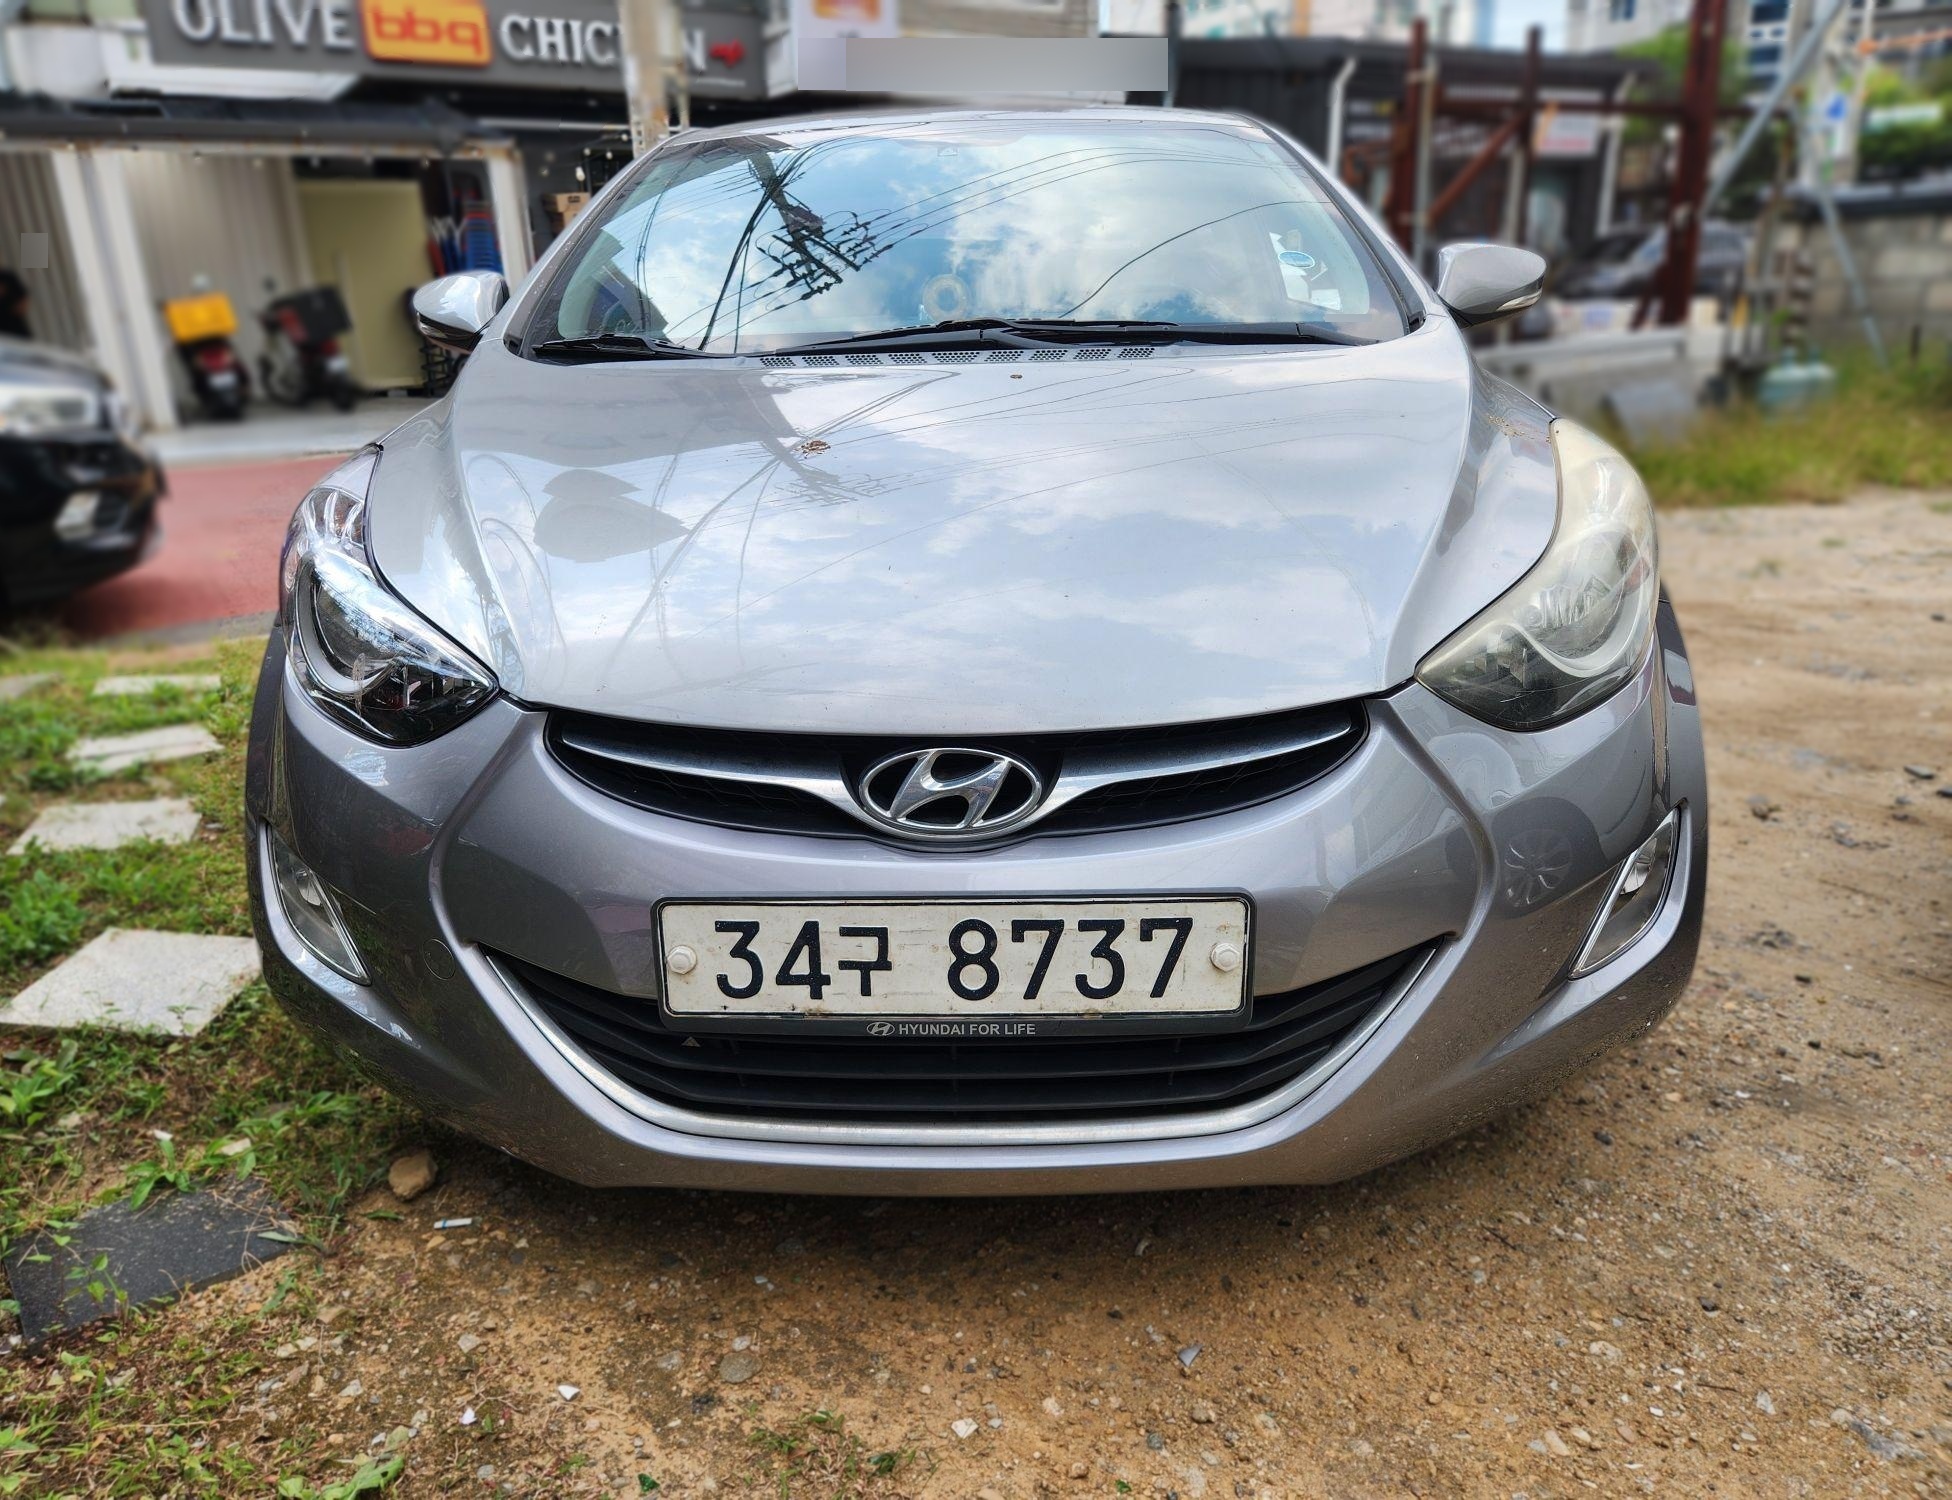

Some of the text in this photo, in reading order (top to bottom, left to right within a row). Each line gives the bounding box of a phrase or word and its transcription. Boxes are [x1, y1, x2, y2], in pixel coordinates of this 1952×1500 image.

[171, 0, 706, 71] OLIVE bbq CHICN
[715, 917, 1194, 1000] 34구 8737
[899, 1023, 1036, 1035] HYUNDAI FOR LIFE
